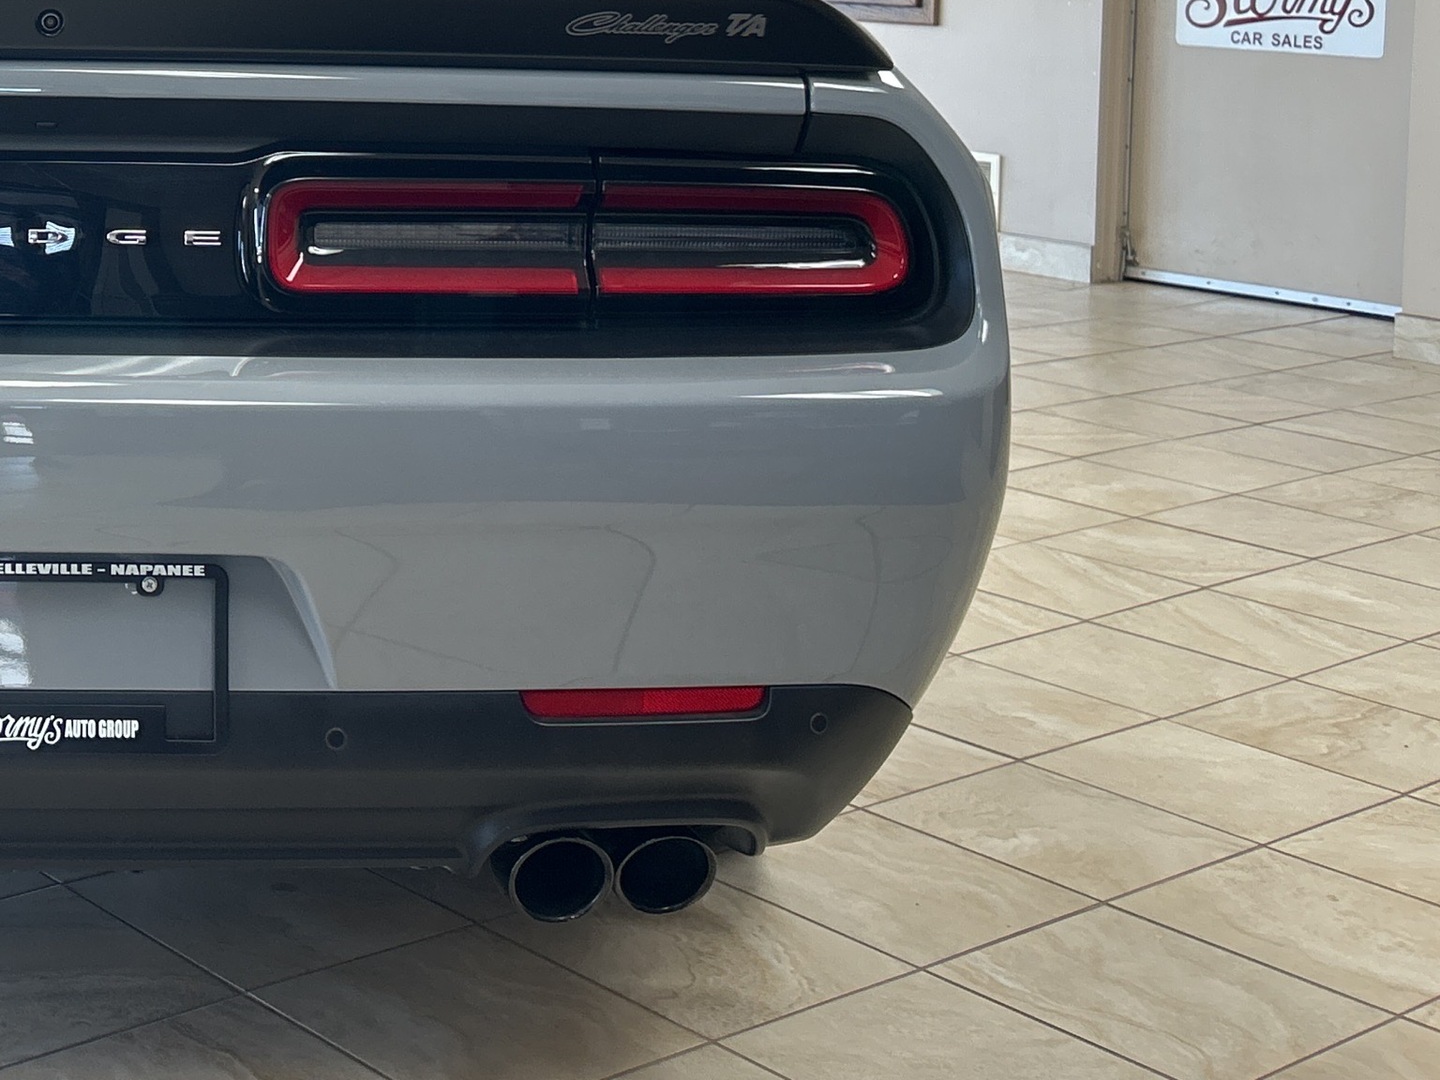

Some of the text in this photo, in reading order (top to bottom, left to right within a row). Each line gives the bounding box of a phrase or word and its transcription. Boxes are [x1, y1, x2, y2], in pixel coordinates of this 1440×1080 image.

[565, 11, 719, 44] Challenger
[1230, 30, 1324, 50] CAR SALES
[110, 563, 206, 577] NAPANEE
[64, 719, 96, 739] AUTO
[98, 719, 140, 739] GROUP
